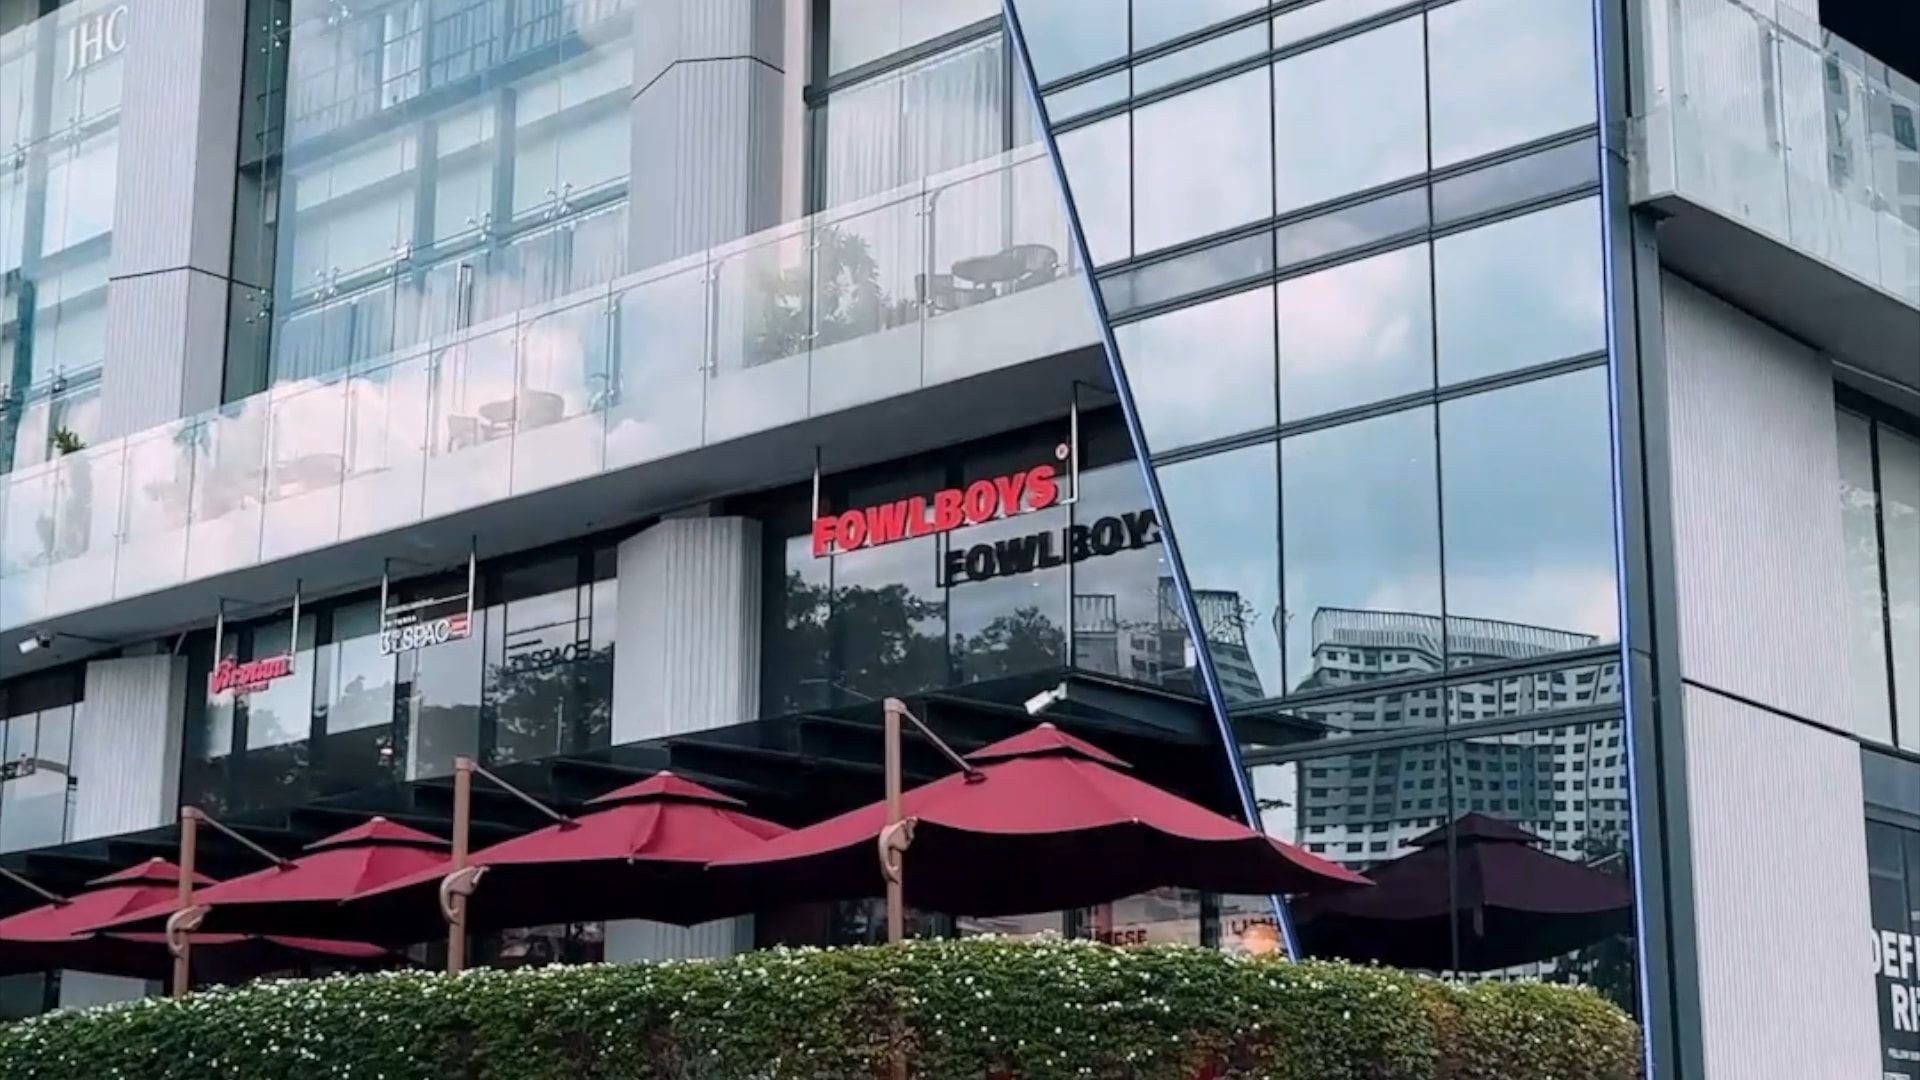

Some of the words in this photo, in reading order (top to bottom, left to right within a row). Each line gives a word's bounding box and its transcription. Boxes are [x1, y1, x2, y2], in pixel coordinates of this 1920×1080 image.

[64, 4, 128, 82] JHC
[812, 464, 1058, 557] FOWLBOYS
[944, 507, 1162, 587] FOWLBOY
